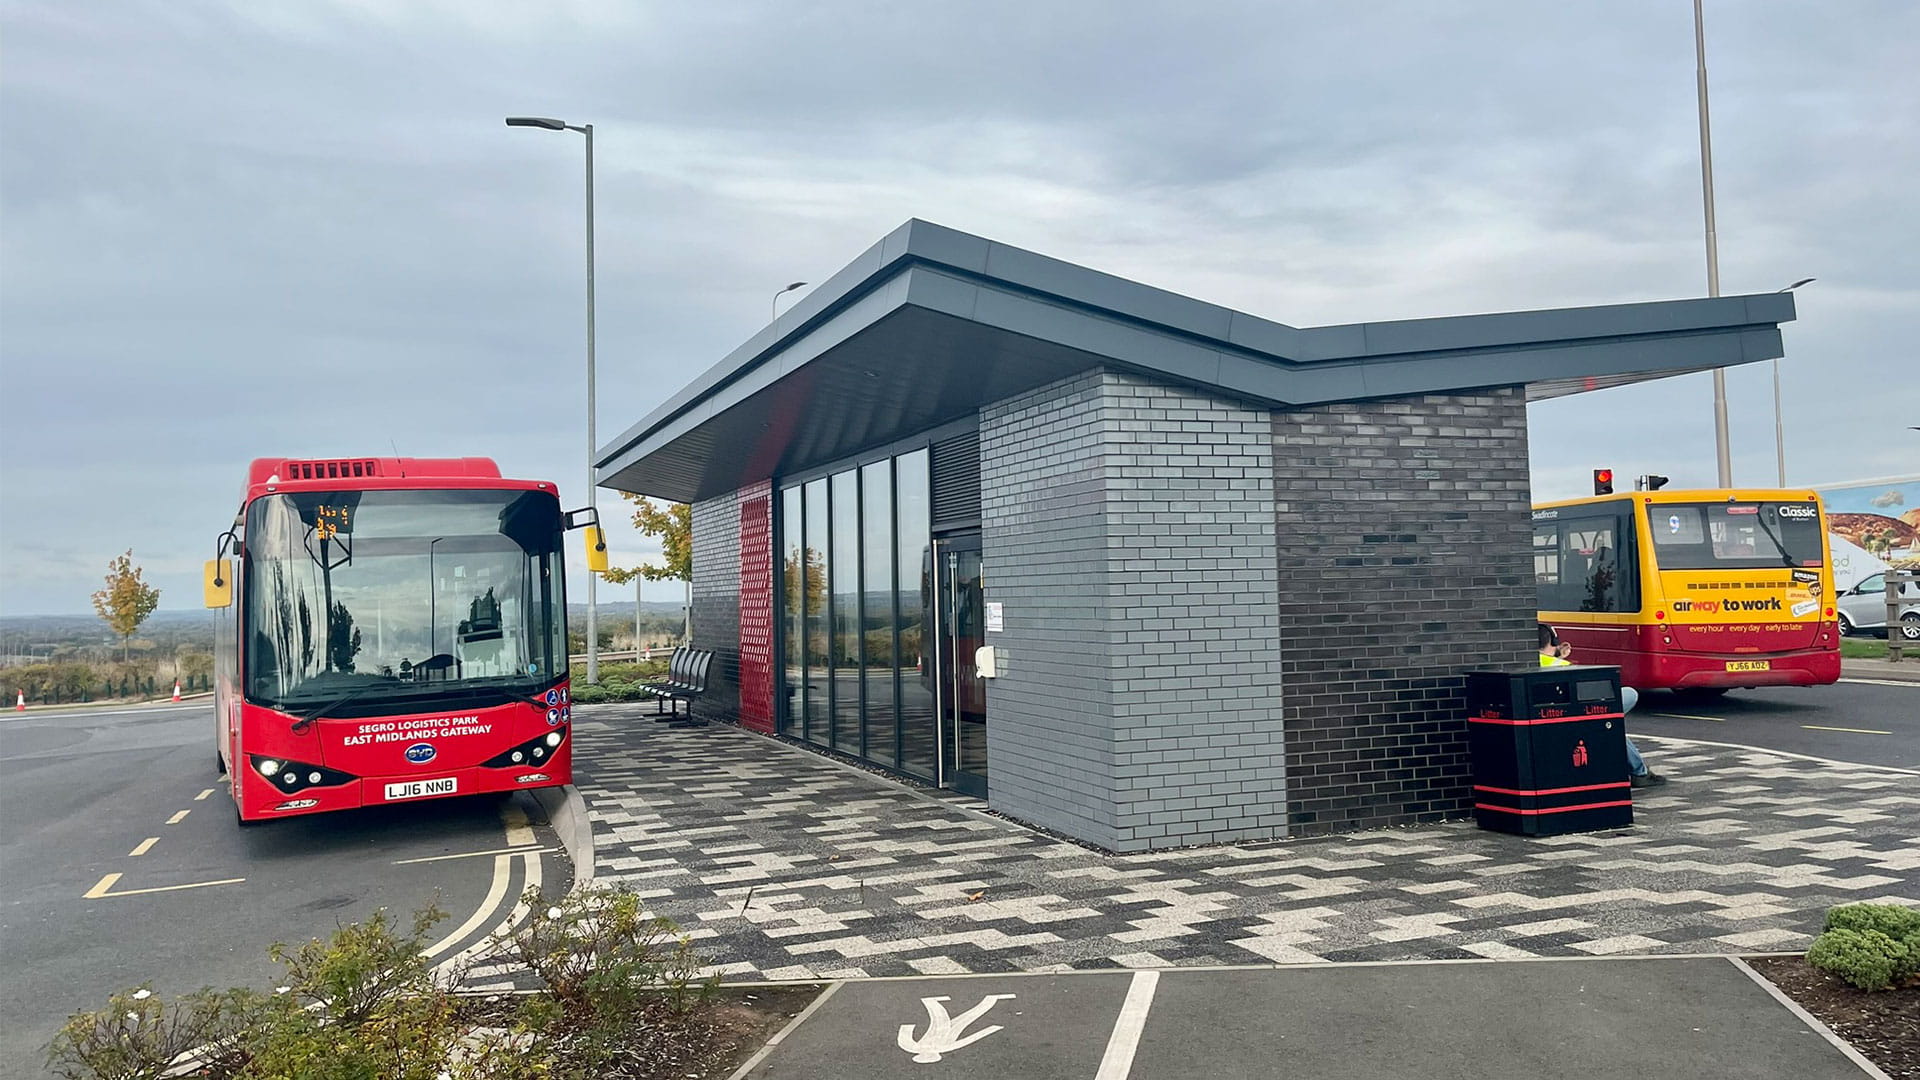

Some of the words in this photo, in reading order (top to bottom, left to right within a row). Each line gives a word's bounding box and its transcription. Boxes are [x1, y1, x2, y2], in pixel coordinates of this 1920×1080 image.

[1779, 506, 1816, 517] Classic
[1673, 599, 1720, 614] airway
[1723, 598, 1740, 611] to
[1741, 597, 1782, 611] work
[1748, 624, 1761, 633] day
[1765, 624, 1781, 632] early
[1790, 623, 1803, 631] late
[1480, 708, 1500, 718] Litter
[1540, 708, 1563, 718] Litter
[1585, 704, 1608, 715] Litter
[358, 723, 395, 734] SEGRO
[398, 718, 450, 730] LOGISTICS
[452, 716, 479, 726] PARK
[344, 734, 373, 746] EAST
[375, 728, 438, 743] MIDLANDS
[440, 725, 492, 737] GATEWAY
[407, 747, 433, 758] BYD
[388, 783, 421, 798] LJ16
[425, 780, 453, 793] NNB
